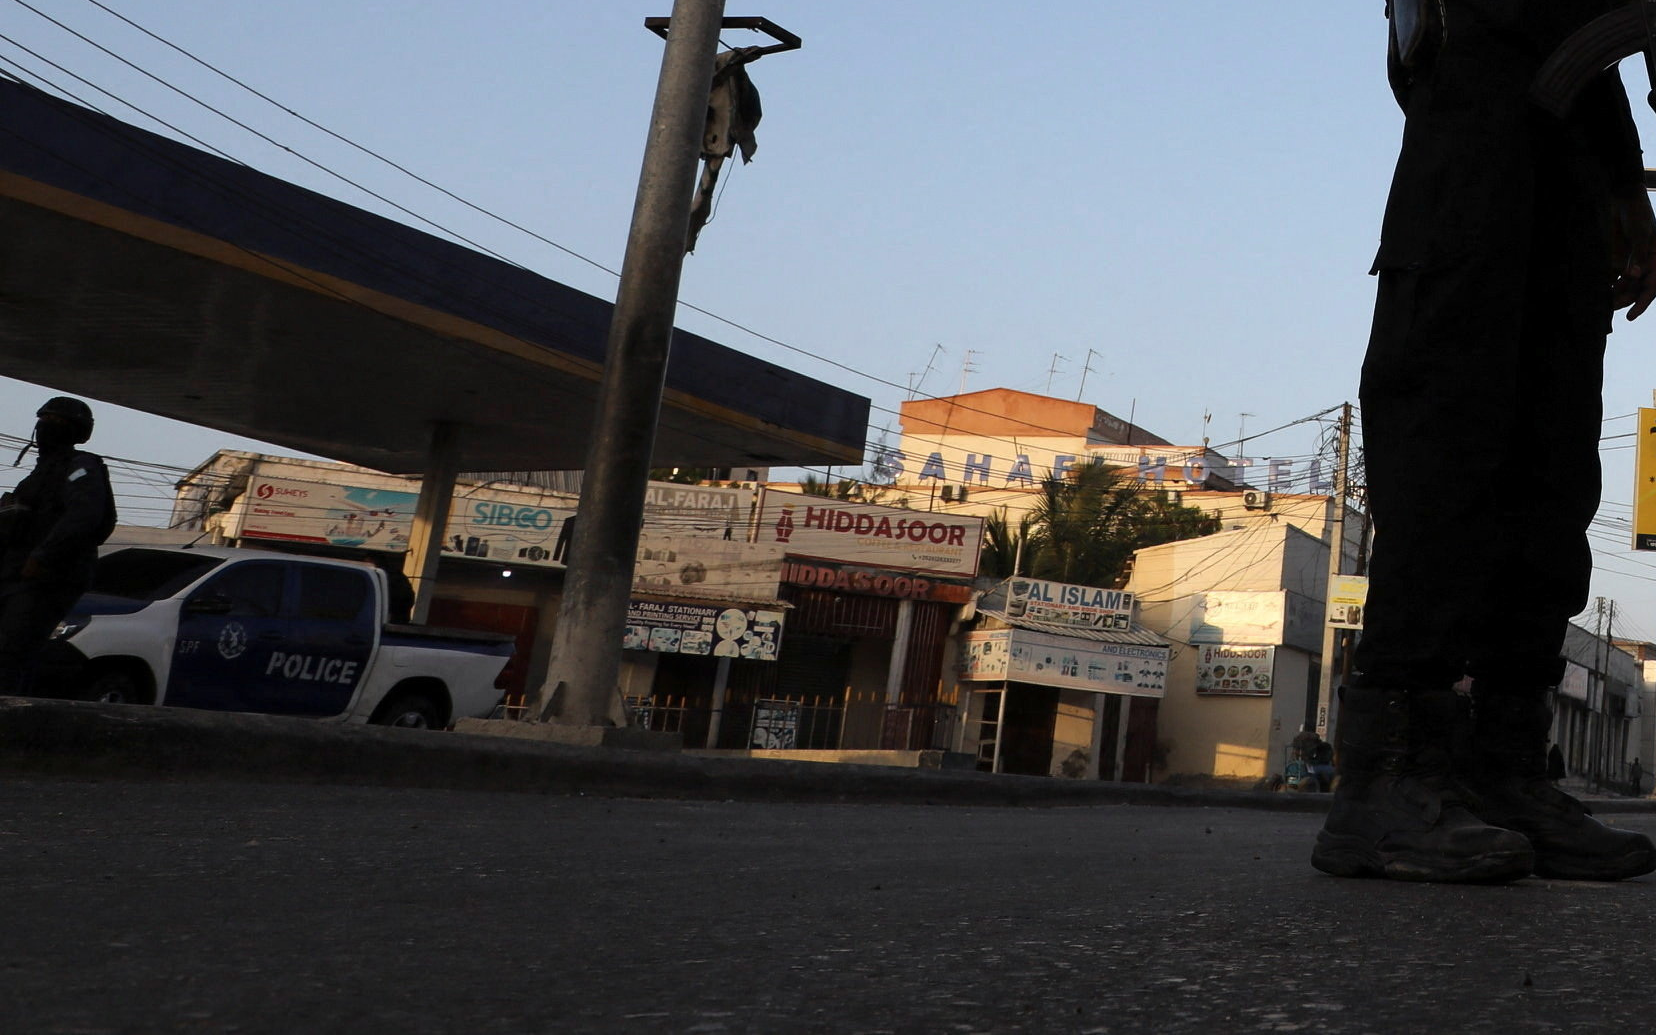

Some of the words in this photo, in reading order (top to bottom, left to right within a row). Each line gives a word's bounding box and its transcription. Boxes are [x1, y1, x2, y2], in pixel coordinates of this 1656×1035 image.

[1137, 454, 1334, 495] HOTEL
[644, 487, 735, 513] AL-FARAJ
[471, 501, 553, 531] SIBCO
[804, 506, 966, 547] HIDDASOOR
[639, 602, 665, 613] FARAJ
[667, 604, 718, 618] STATIONARY
[1027, 581, 1054, 603] AL
[1060, 584, 1122, 611] ISLAM
[1030, 600, 1066, 611] STATIONARY
[642, 610, 674, 621] PRINTING
[1102, 644, 1118, 654] AND
[1119, 646, 1167, 660] ELECTRONICS
[265, 651, 358, 685] POLICE
